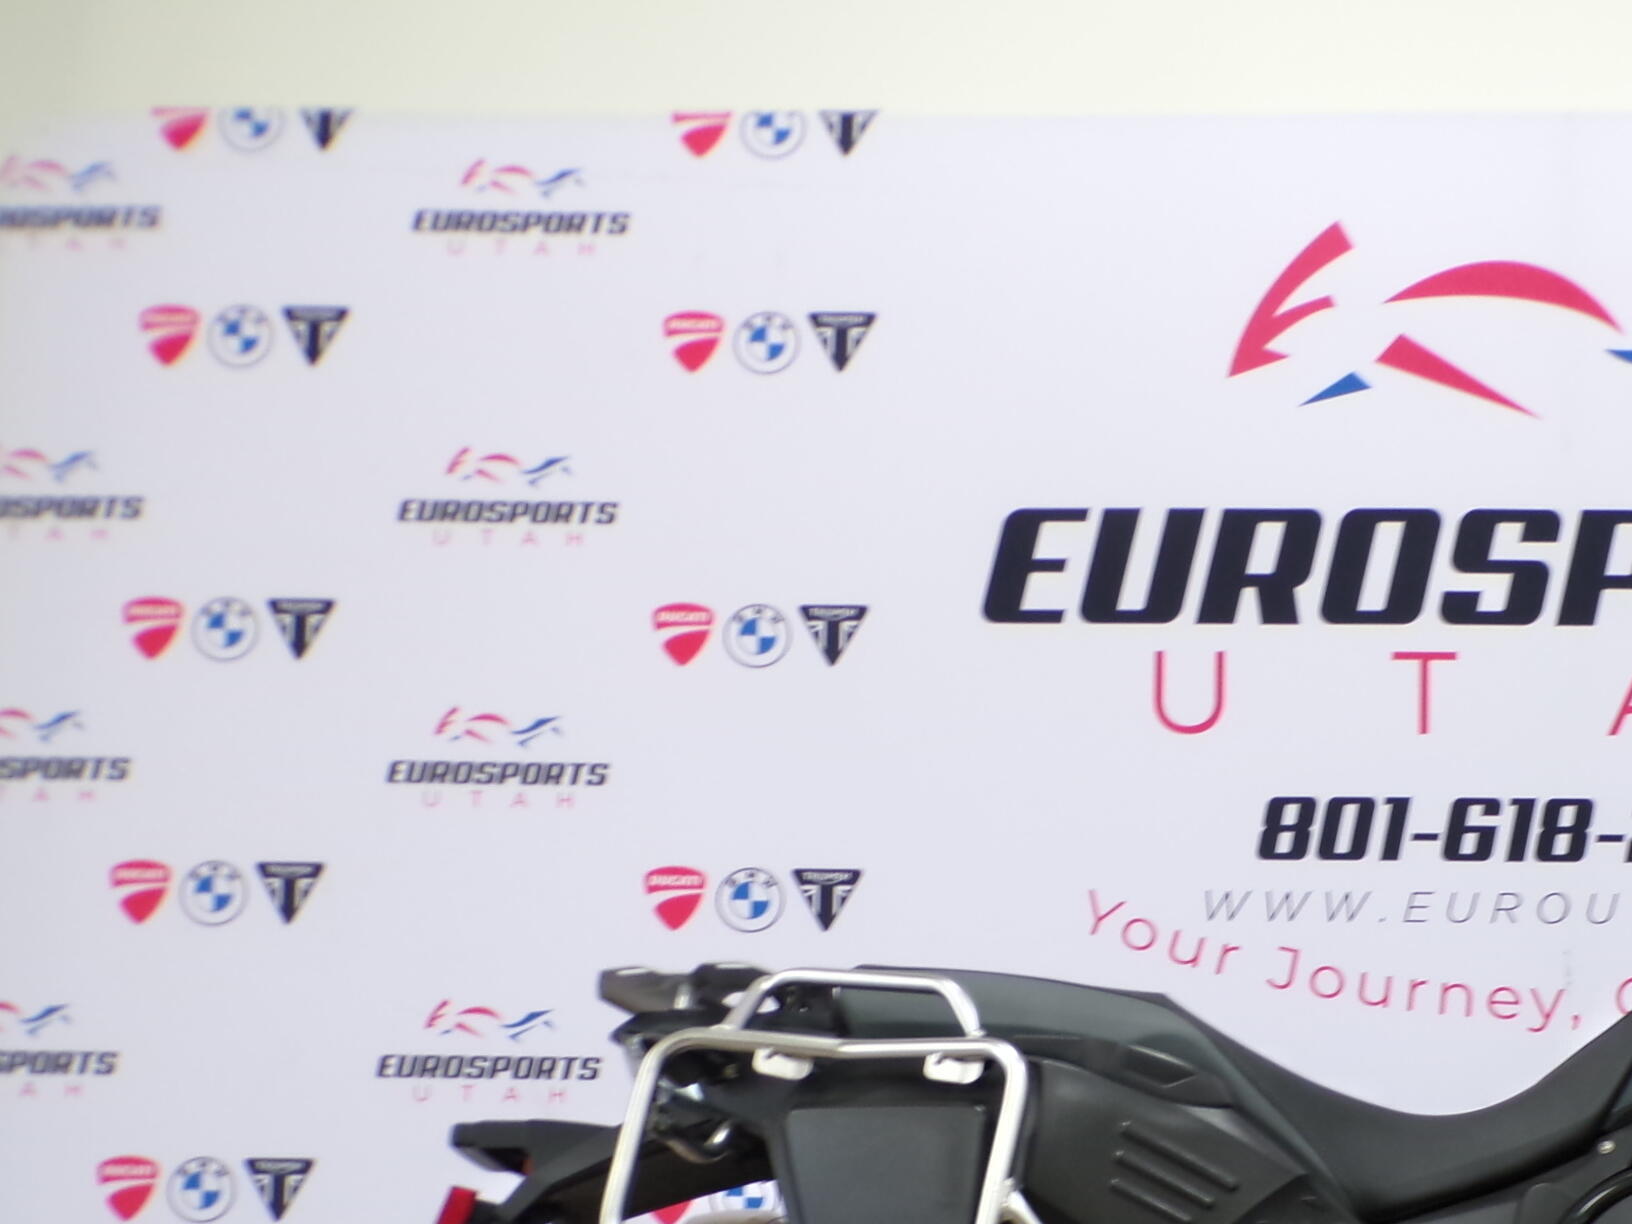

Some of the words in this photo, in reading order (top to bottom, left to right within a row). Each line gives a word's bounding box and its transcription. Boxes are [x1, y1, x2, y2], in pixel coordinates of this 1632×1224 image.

[412, 210, 630, 236] EUROSPORTS
[398, 499, 619, 526] EUROSPORTS
[387, 760, 610, 787] EUROSPORTS
[1088, 889, 1242, 976] Your
[1266, 945, 1582, 1031] Journey,
[377, 1053, 602, 1081] EUROSPORTS
